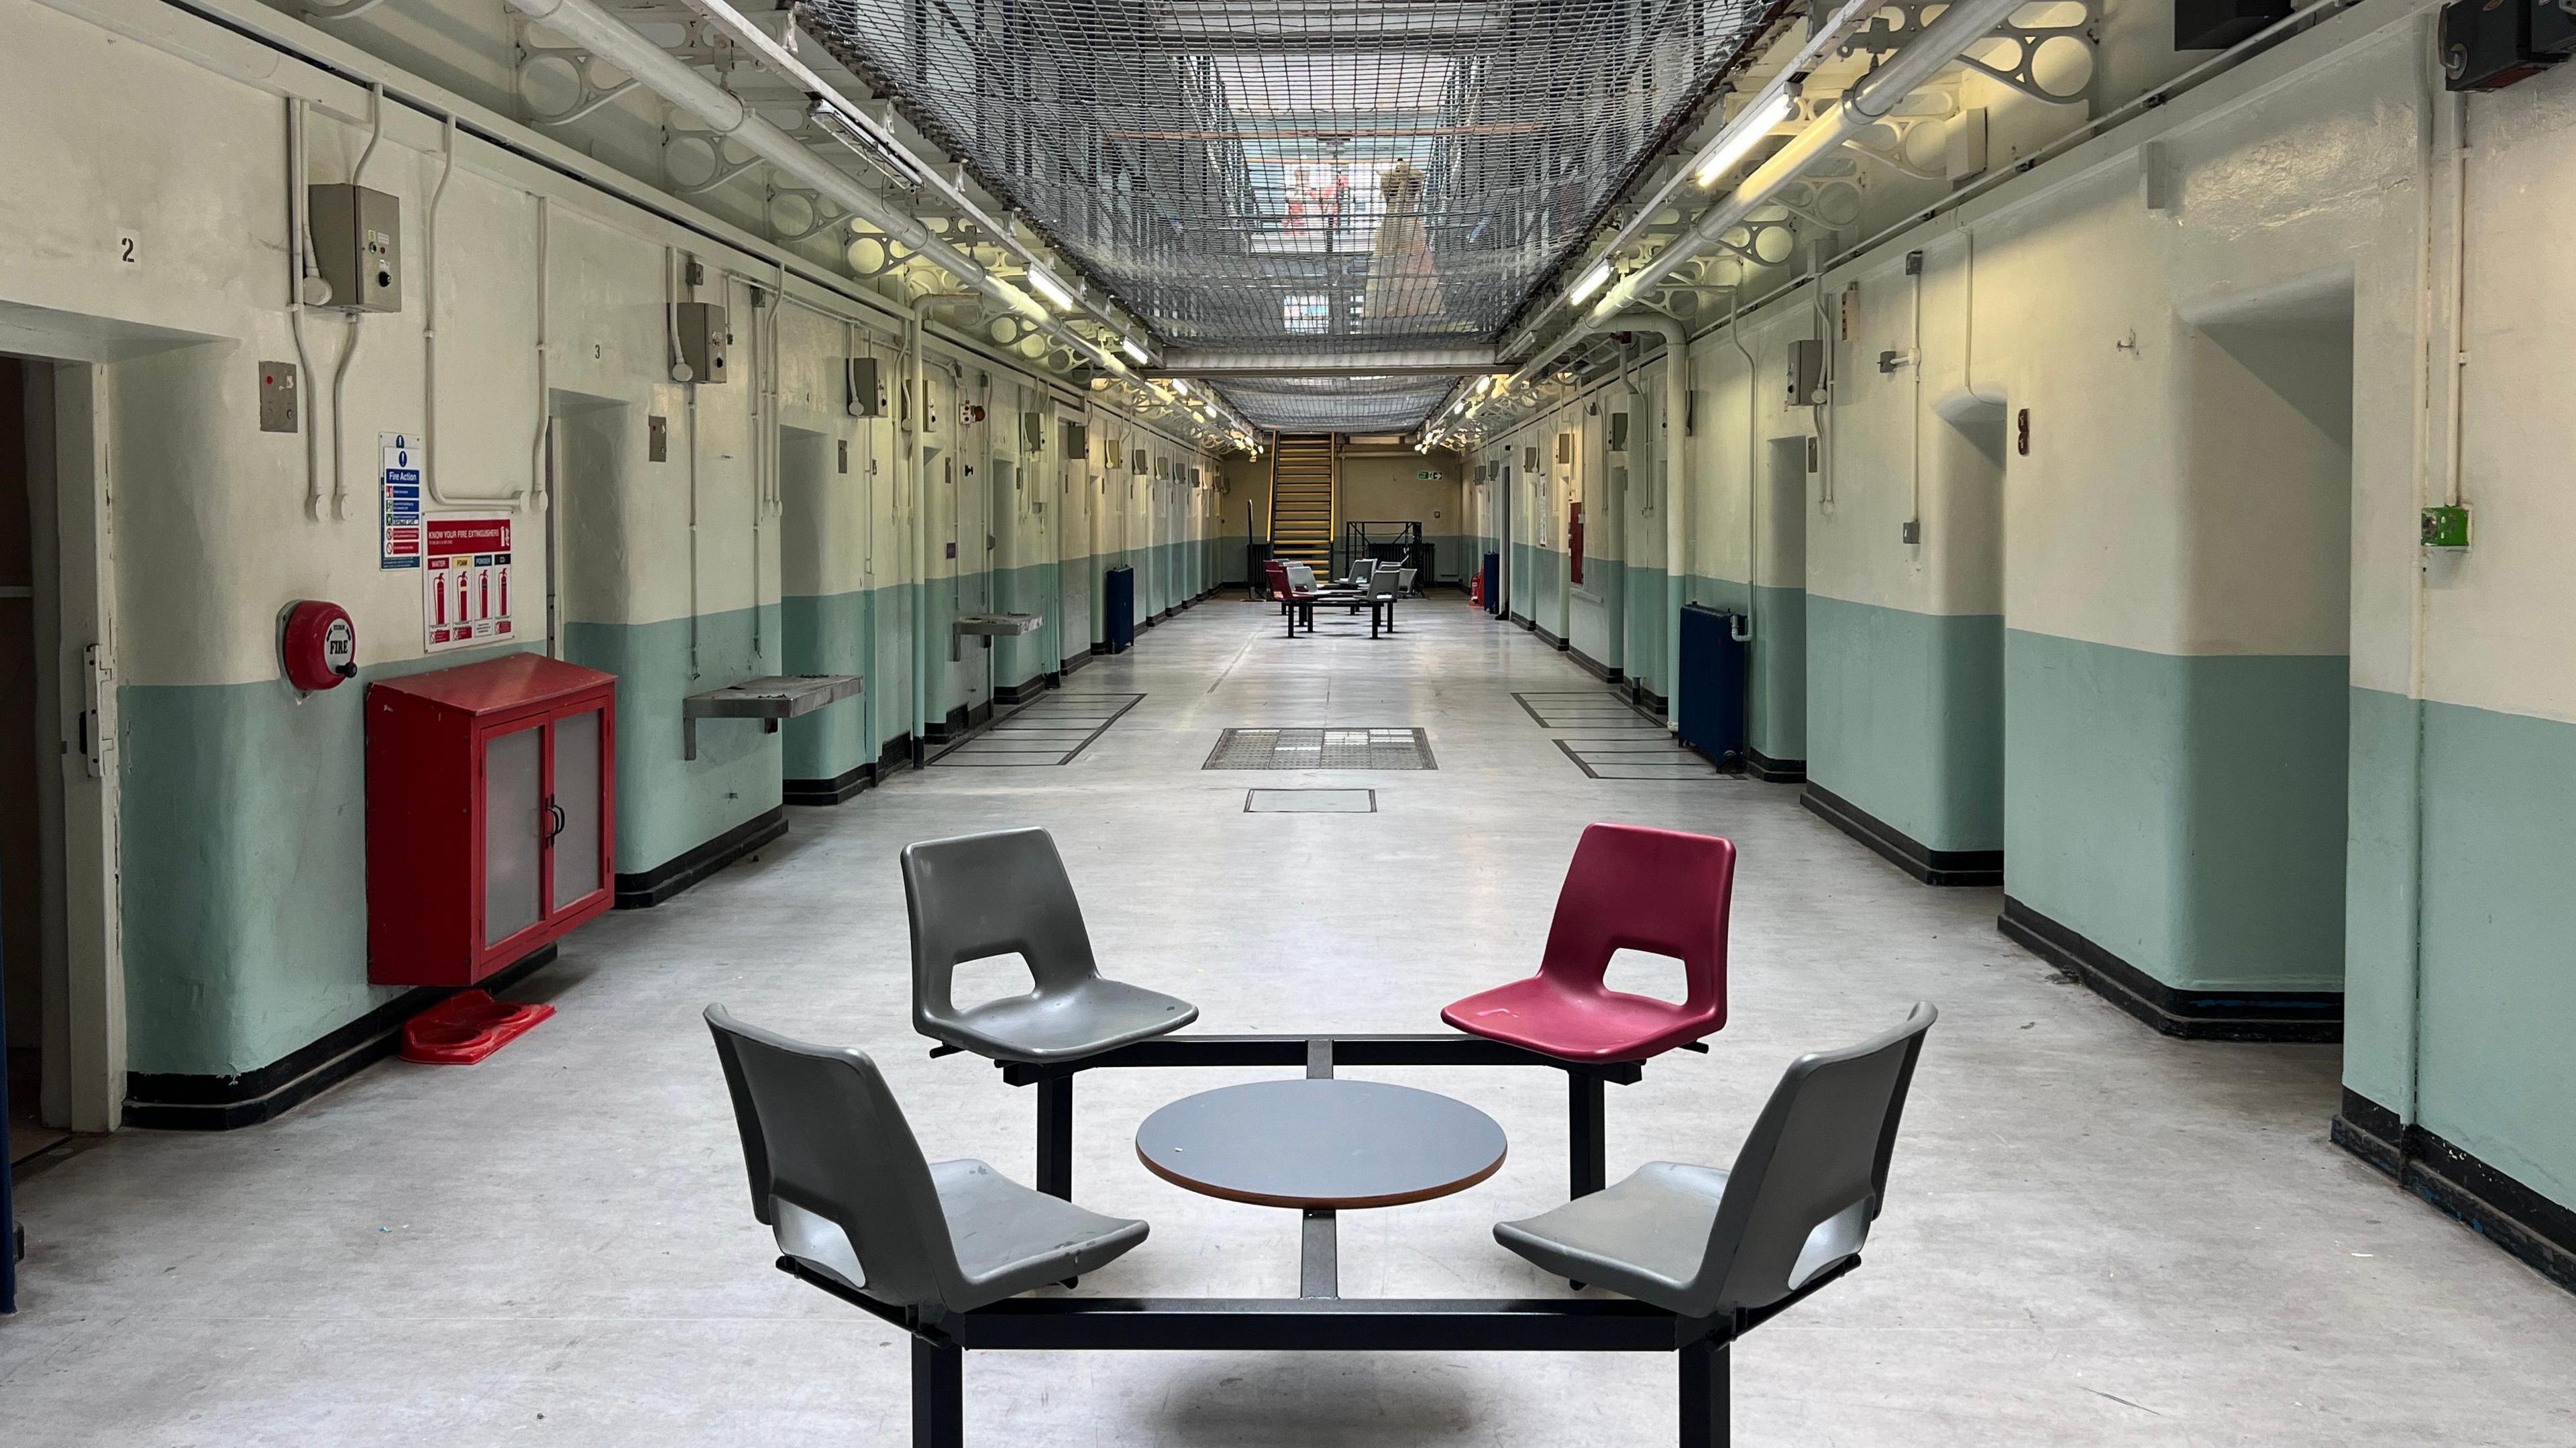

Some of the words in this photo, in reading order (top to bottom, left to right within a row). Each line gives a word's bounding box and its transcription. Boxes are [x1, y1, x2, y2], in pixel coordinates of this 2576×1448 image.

[121, 237, 135, 263] 2
[594, 344, 600, 359] 3
[389, 471, 399, 481] Fire
[400, 471, 417, 482] Action
[429, 531, 443, 539] KNOW
[444, 531, 457, 539] YOUR
[458, 530, 468, 538] FIRE
[468, 529, 499, 537] EXTINGUISHERS
[330, 640, 347, 655] FIRE
